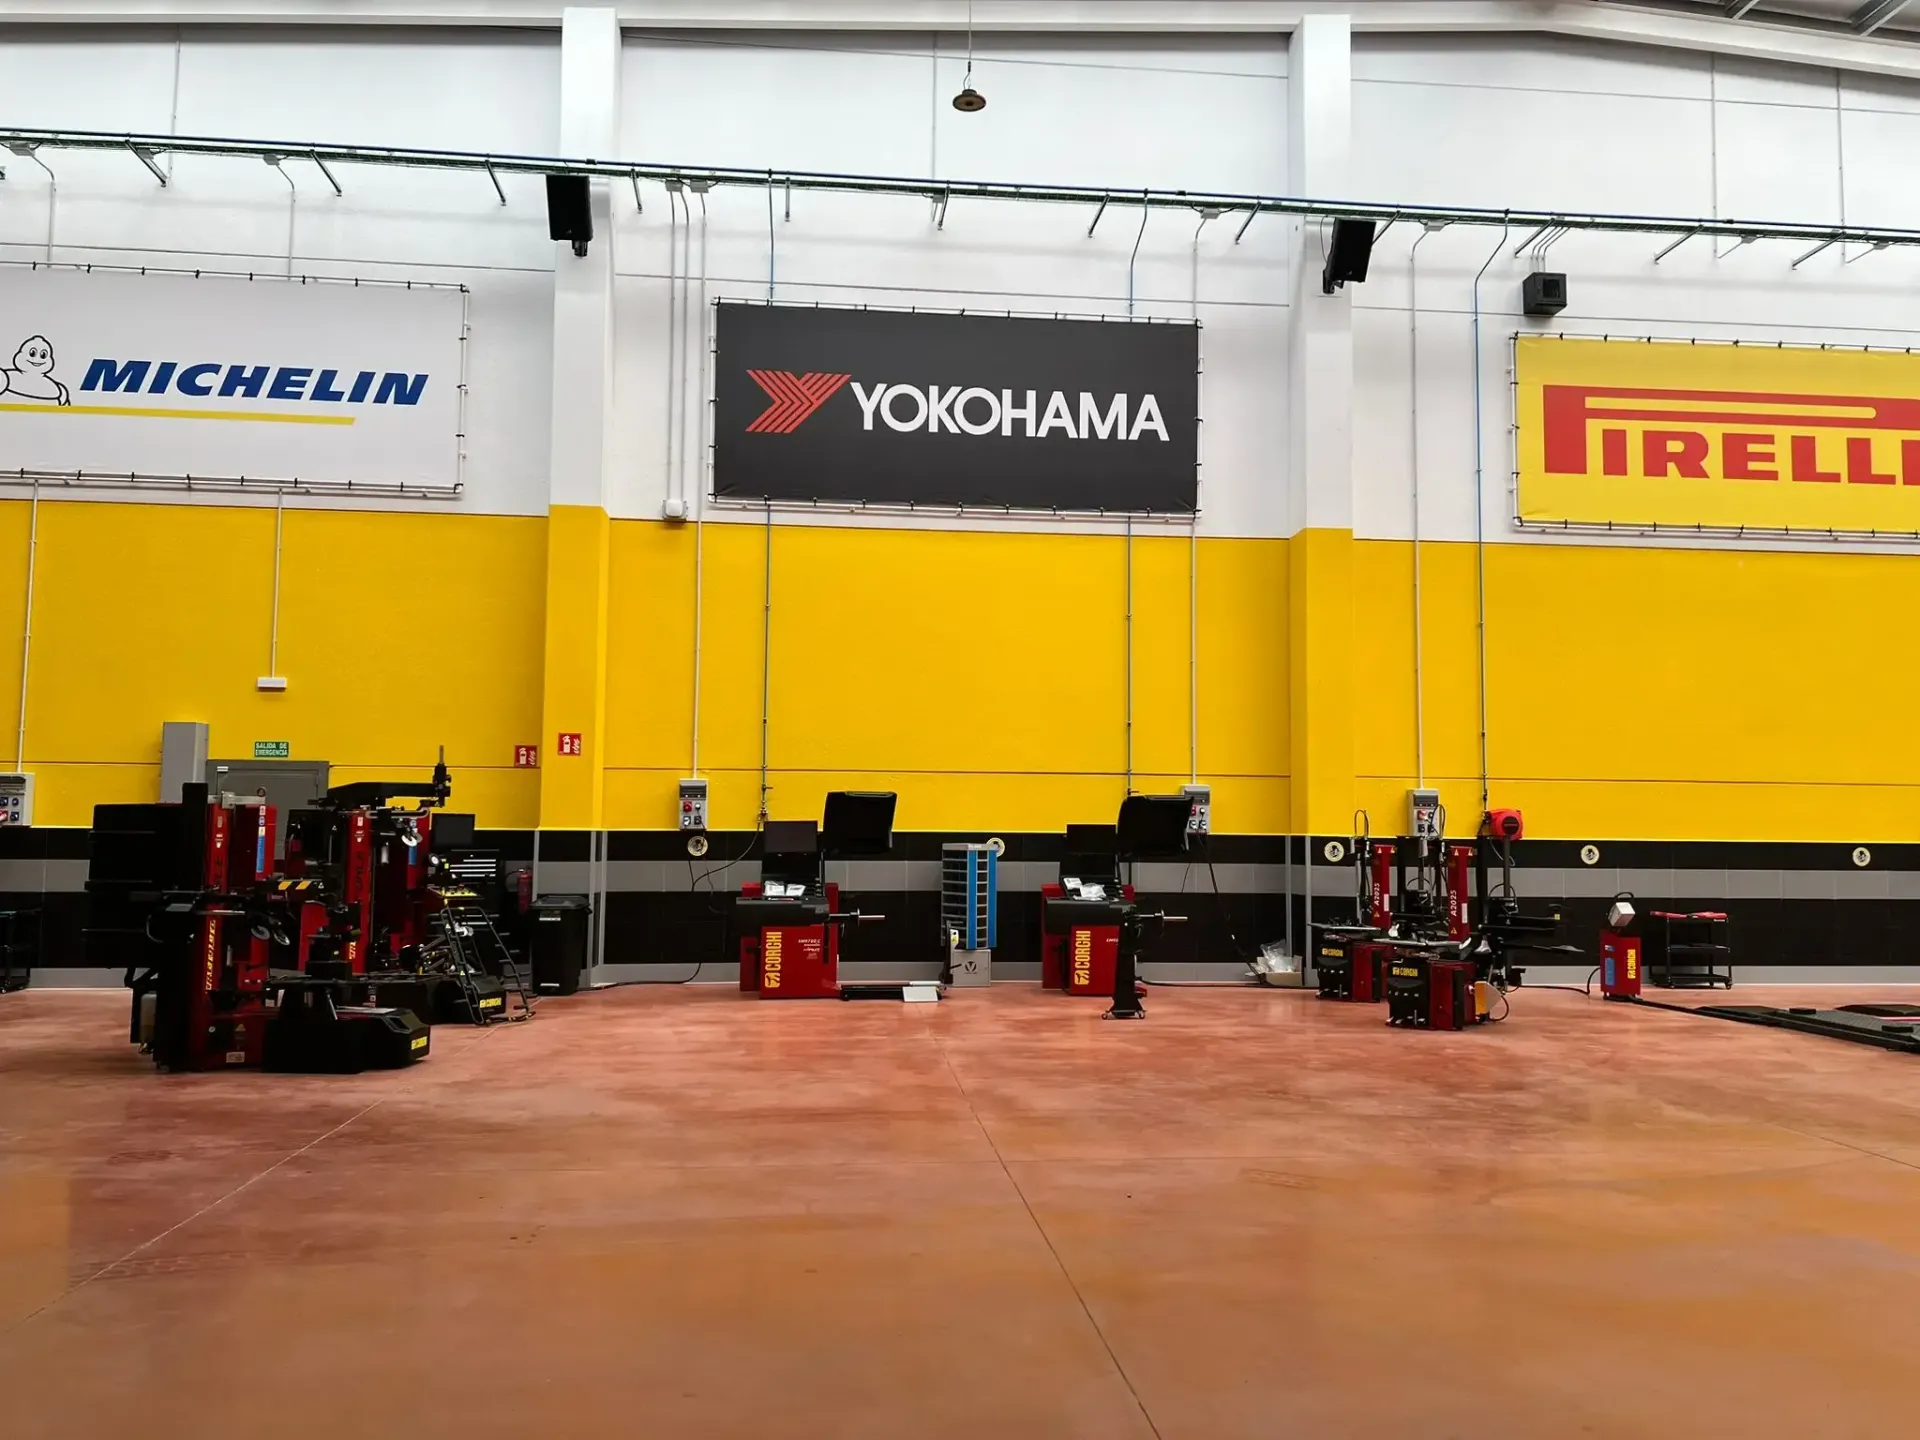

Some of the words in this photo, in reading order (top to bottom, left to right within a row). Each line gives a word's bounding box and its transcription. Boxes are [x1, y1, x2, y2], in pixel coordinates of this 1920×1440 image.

[80, 358, 429, 406] MICHELIN
[849, 381, 1170, 442] YOKOHAMA
[764, 931, 783, 971] CORGHI
[1074, 930, 1092, 969] CORGHI
[1400, 967, 1418, 977] CORGHI
